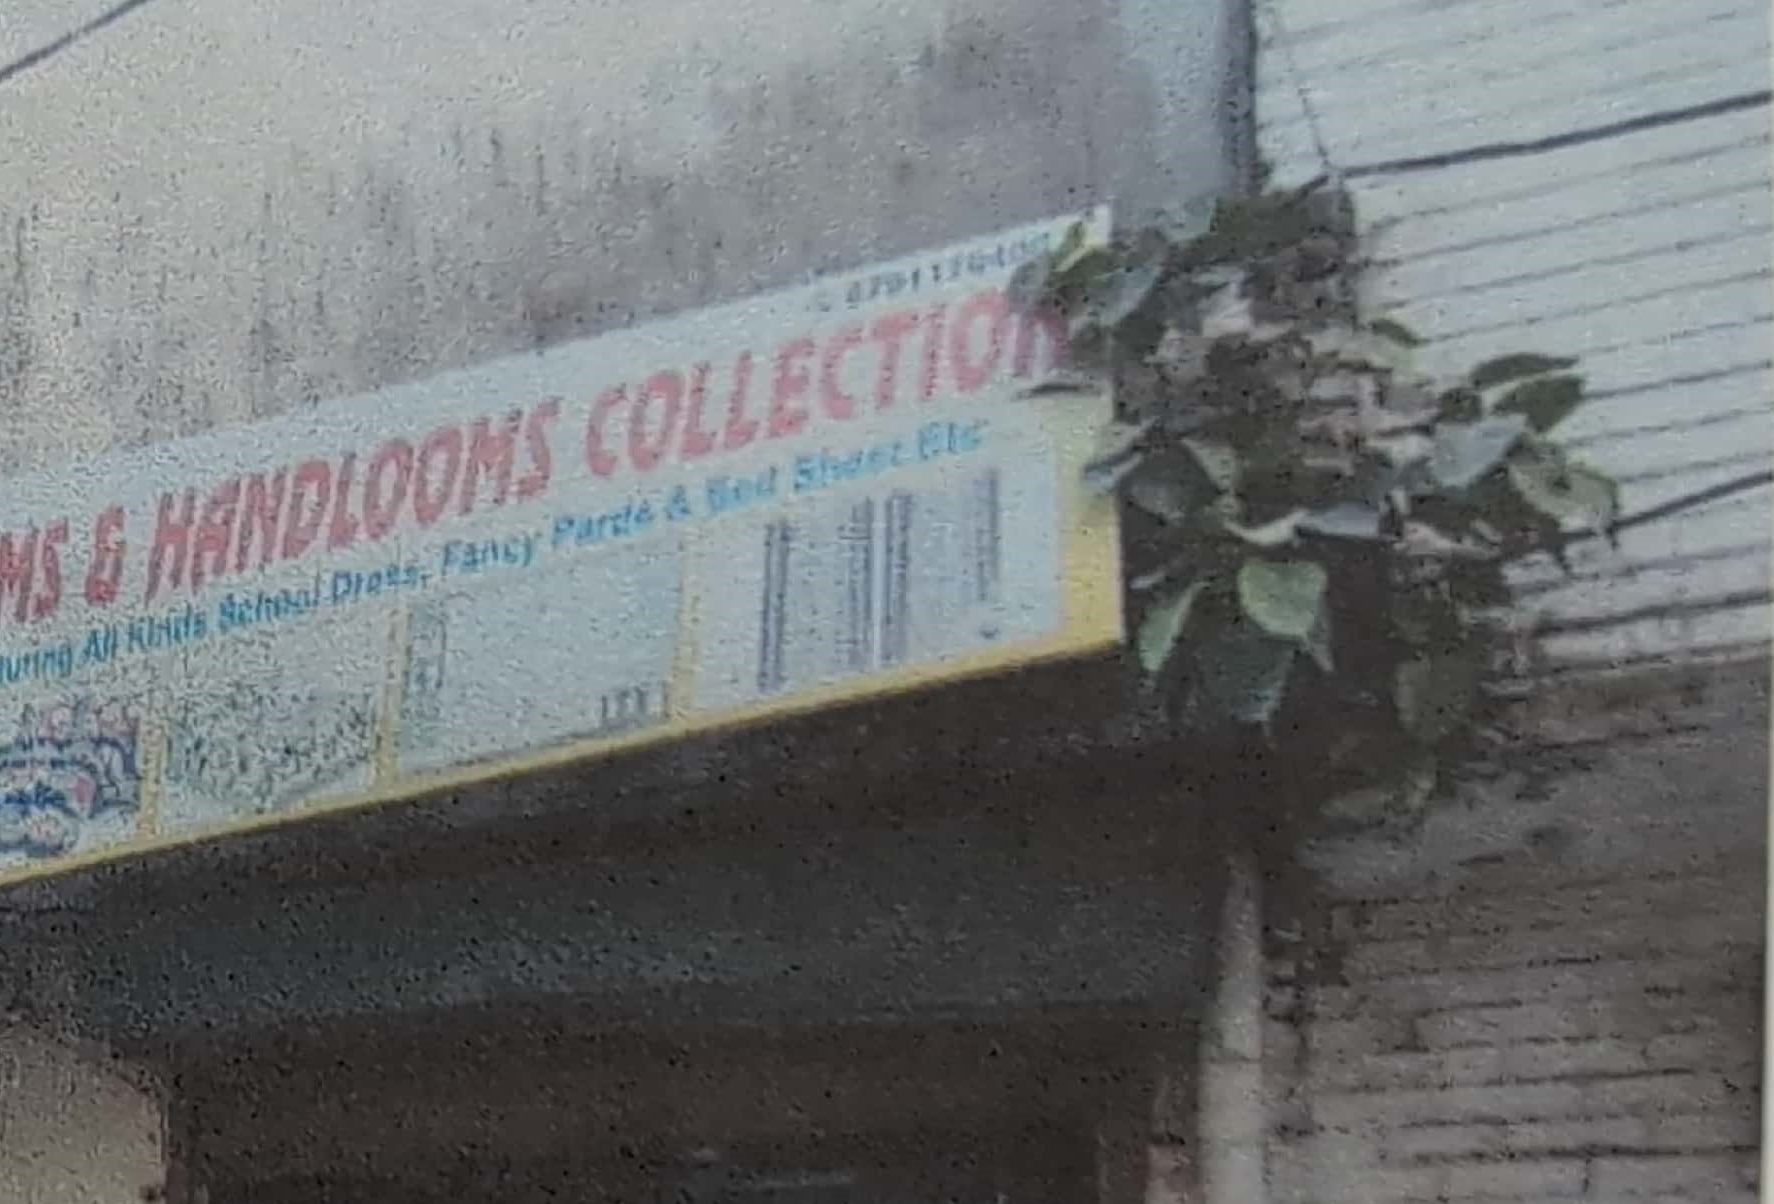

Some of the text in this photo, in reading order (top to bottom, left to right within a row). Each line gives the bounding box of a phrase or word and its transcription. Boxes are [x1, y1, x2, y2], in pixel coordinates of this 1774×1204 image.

[84, 502, 125, 606] &
[145, 397, 561, 600] HANDLOOMS
[585, 284, 1070, 478] COLLECTION
[83, 621, 120, 666] All
[127, 602, 207, 656] Kinds
[219, 564, 322, 633] School
[440, 533, 541, 574] Fancy
